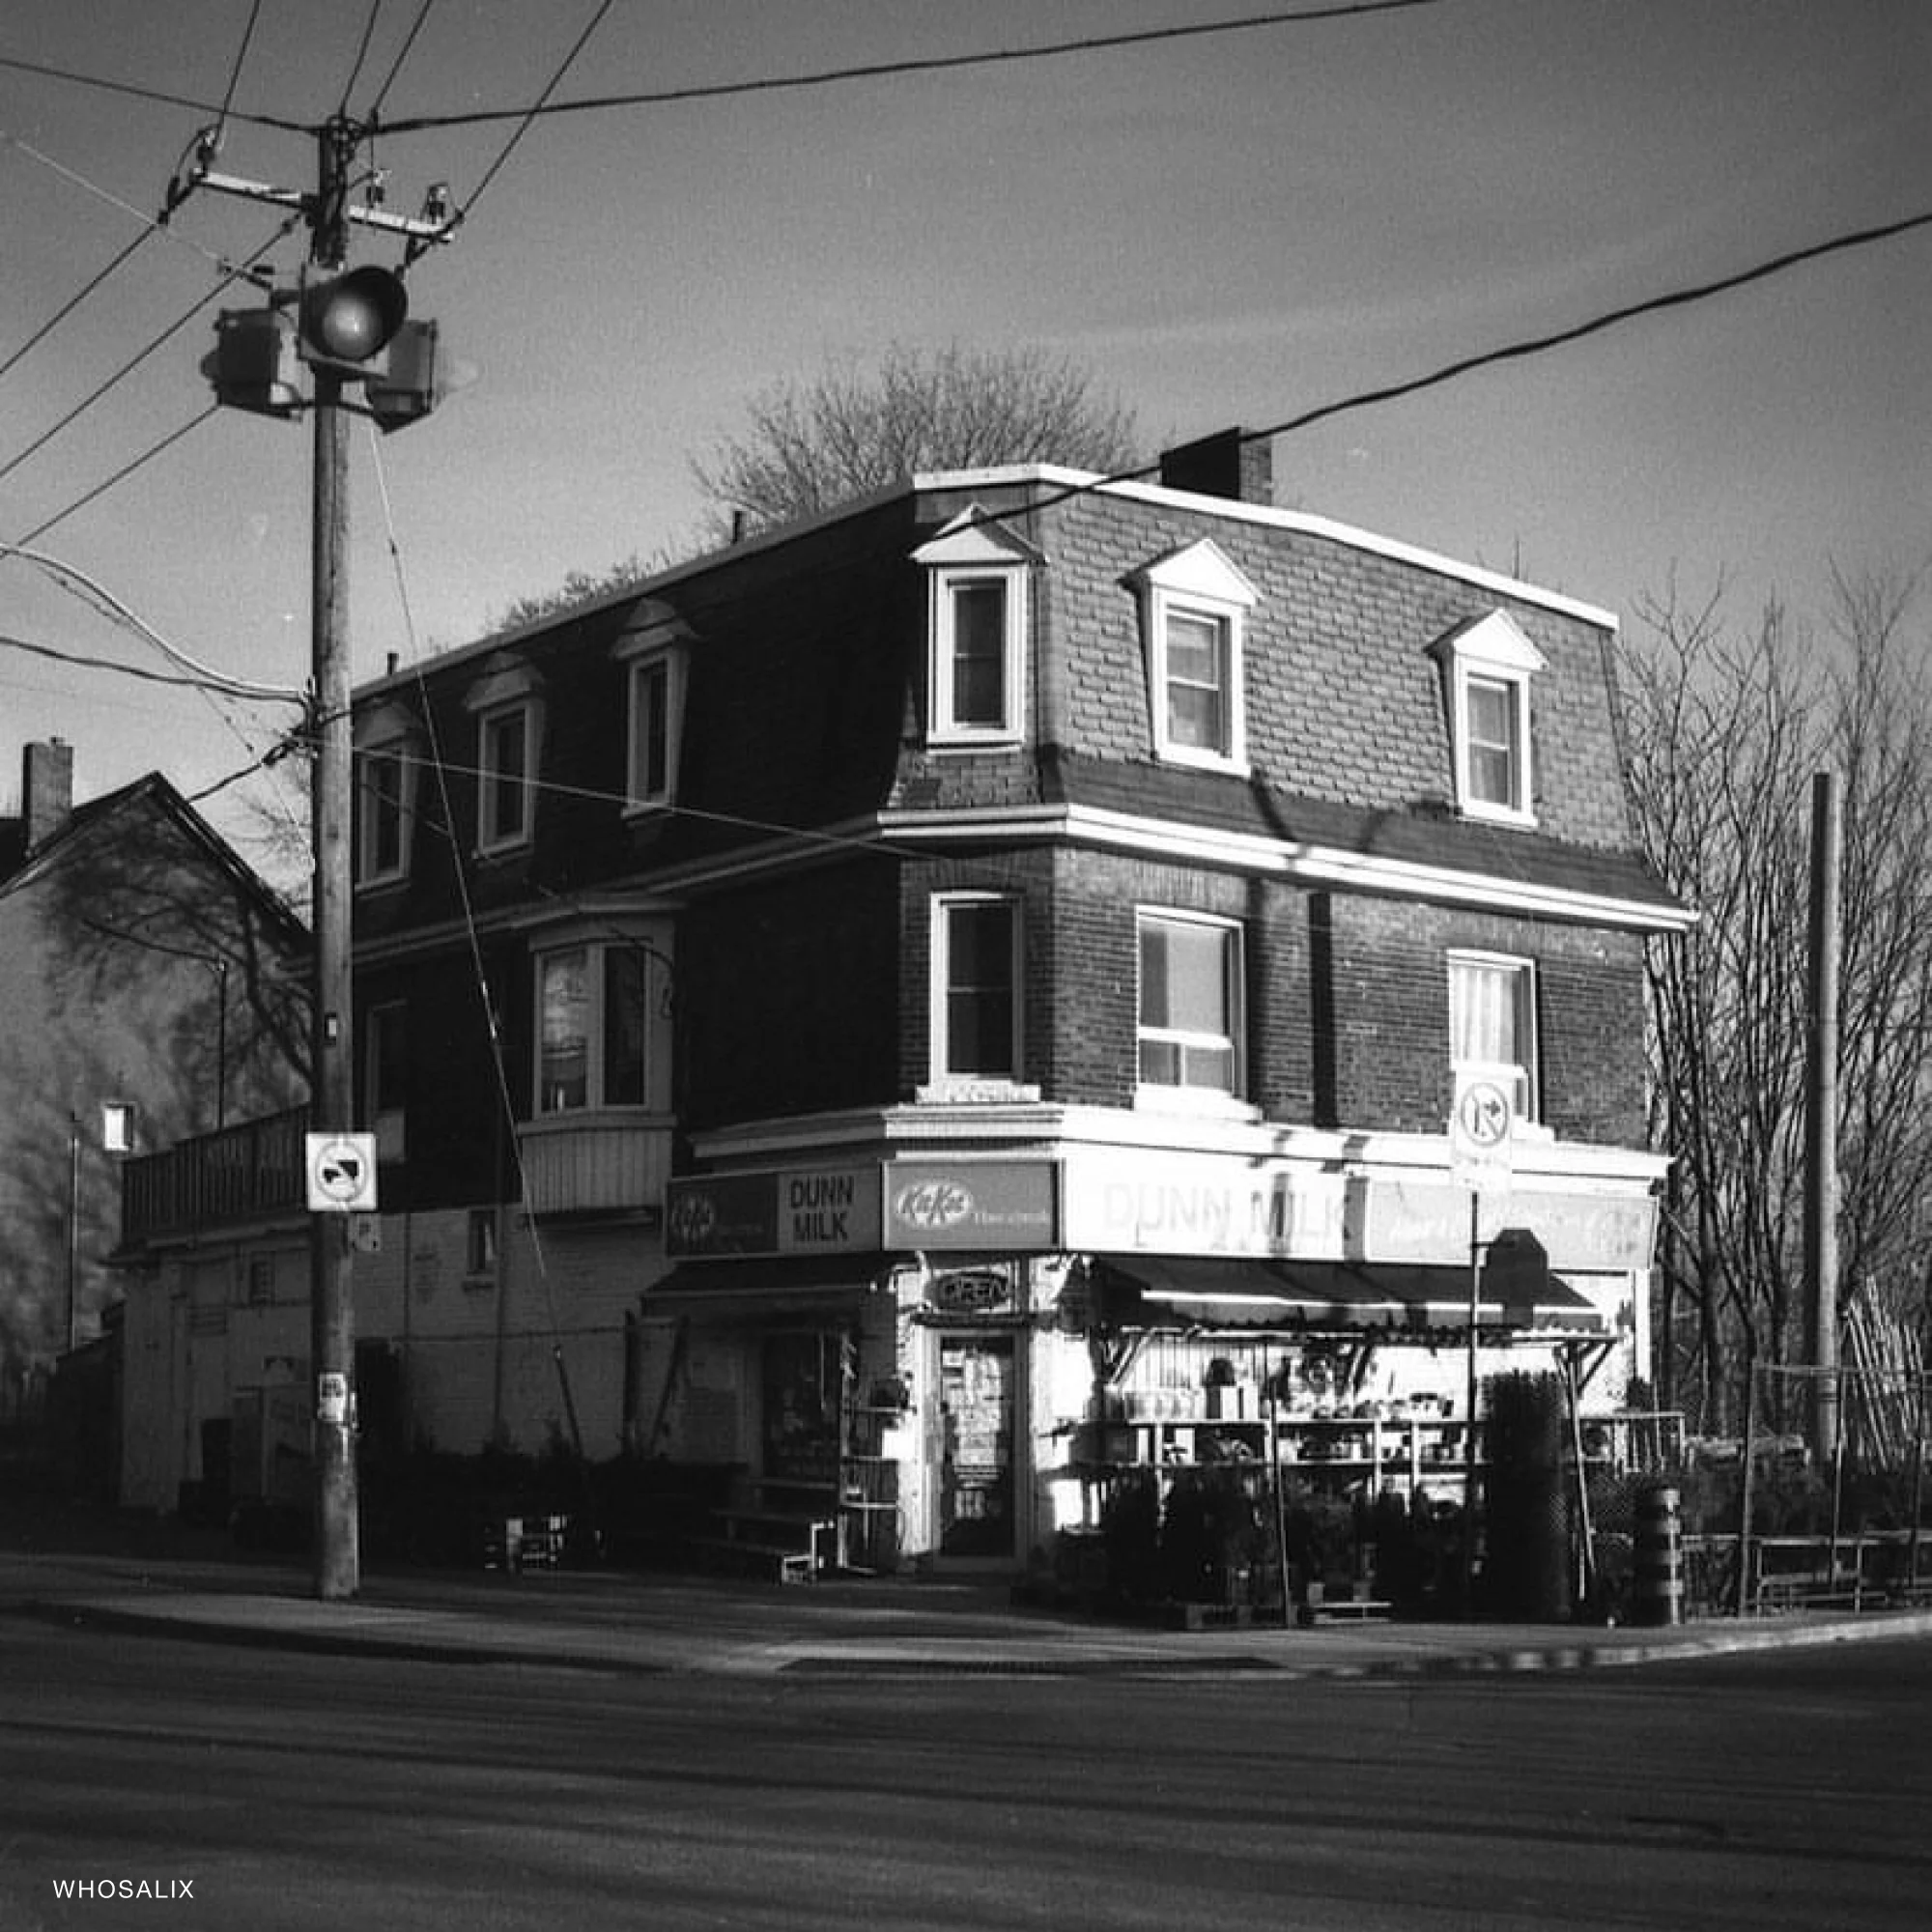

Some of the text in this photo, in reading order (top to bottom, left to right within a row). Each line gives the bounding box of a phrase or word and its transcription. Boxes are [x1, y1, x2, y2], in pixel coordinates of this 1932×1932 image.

[790, 1174, 855, 1208] DUNN
[1102, 1181, 1232, 1235] DUNN
[792, 1211, 849, 1242] MILK
